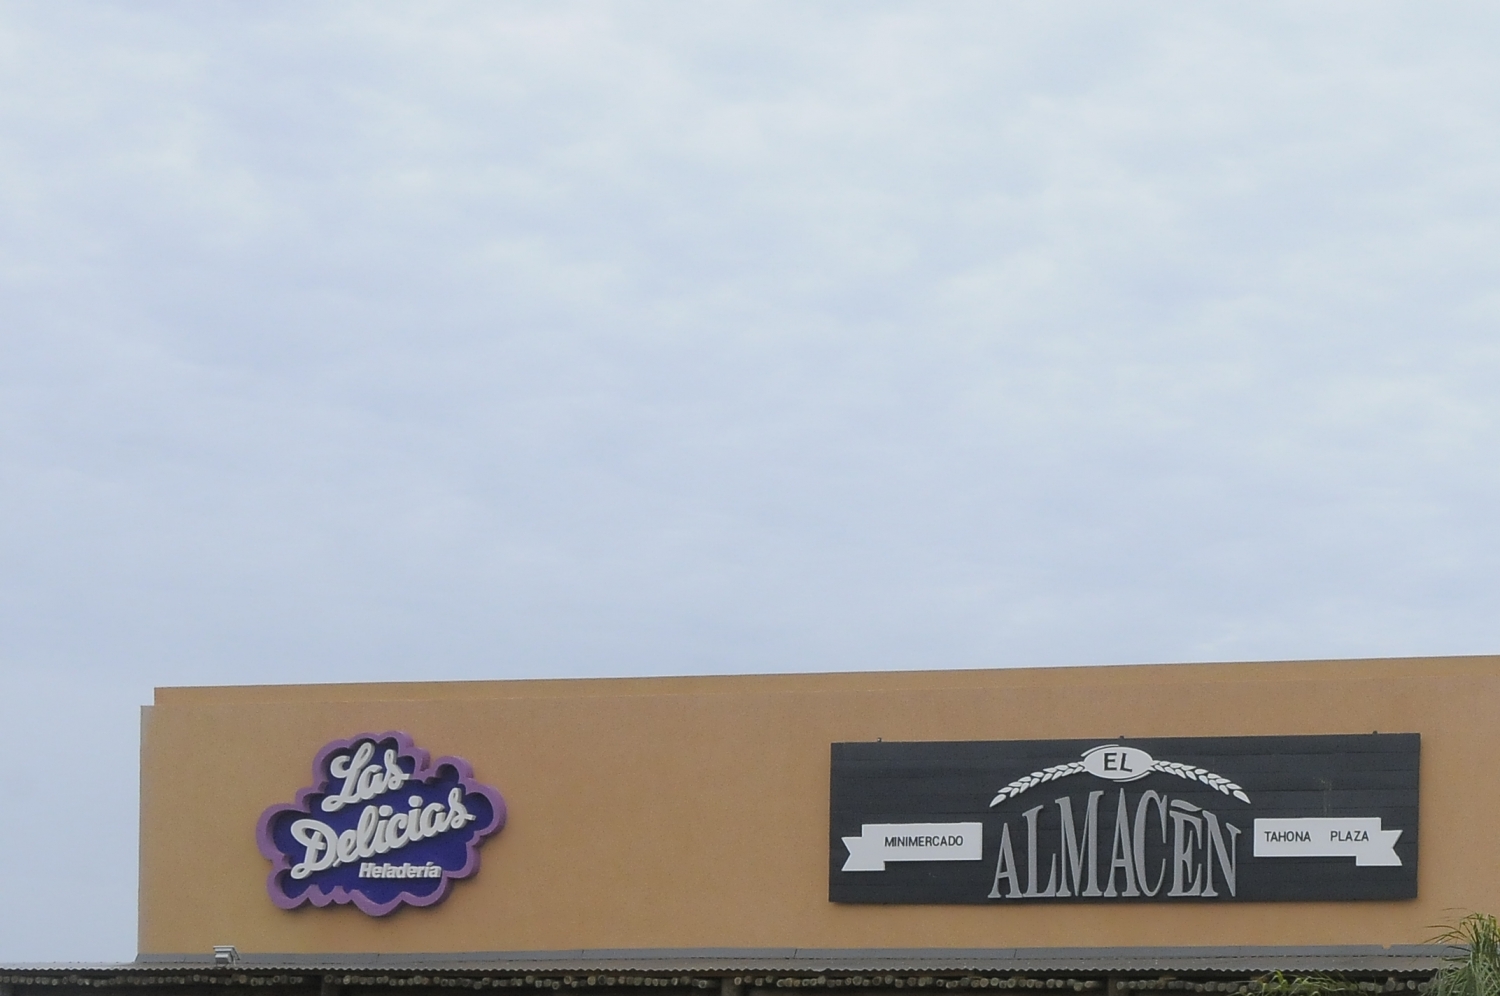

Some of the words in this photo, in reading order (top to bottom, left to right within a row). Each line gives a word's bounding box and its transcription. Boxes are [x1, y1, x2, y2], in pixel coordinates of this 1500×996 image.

[1103, 752, 1133, 773] EL
[321, 742, 410, 811] Las
[290, 787, 476, 879] Delicias
[884, 834, 965, 848] MINIMERCADO
[1263, 830, 1312, 844] TAHONA
[1330, 829, 1370, 843] PLAZA
[358, 861, 443, 878] Heladería
